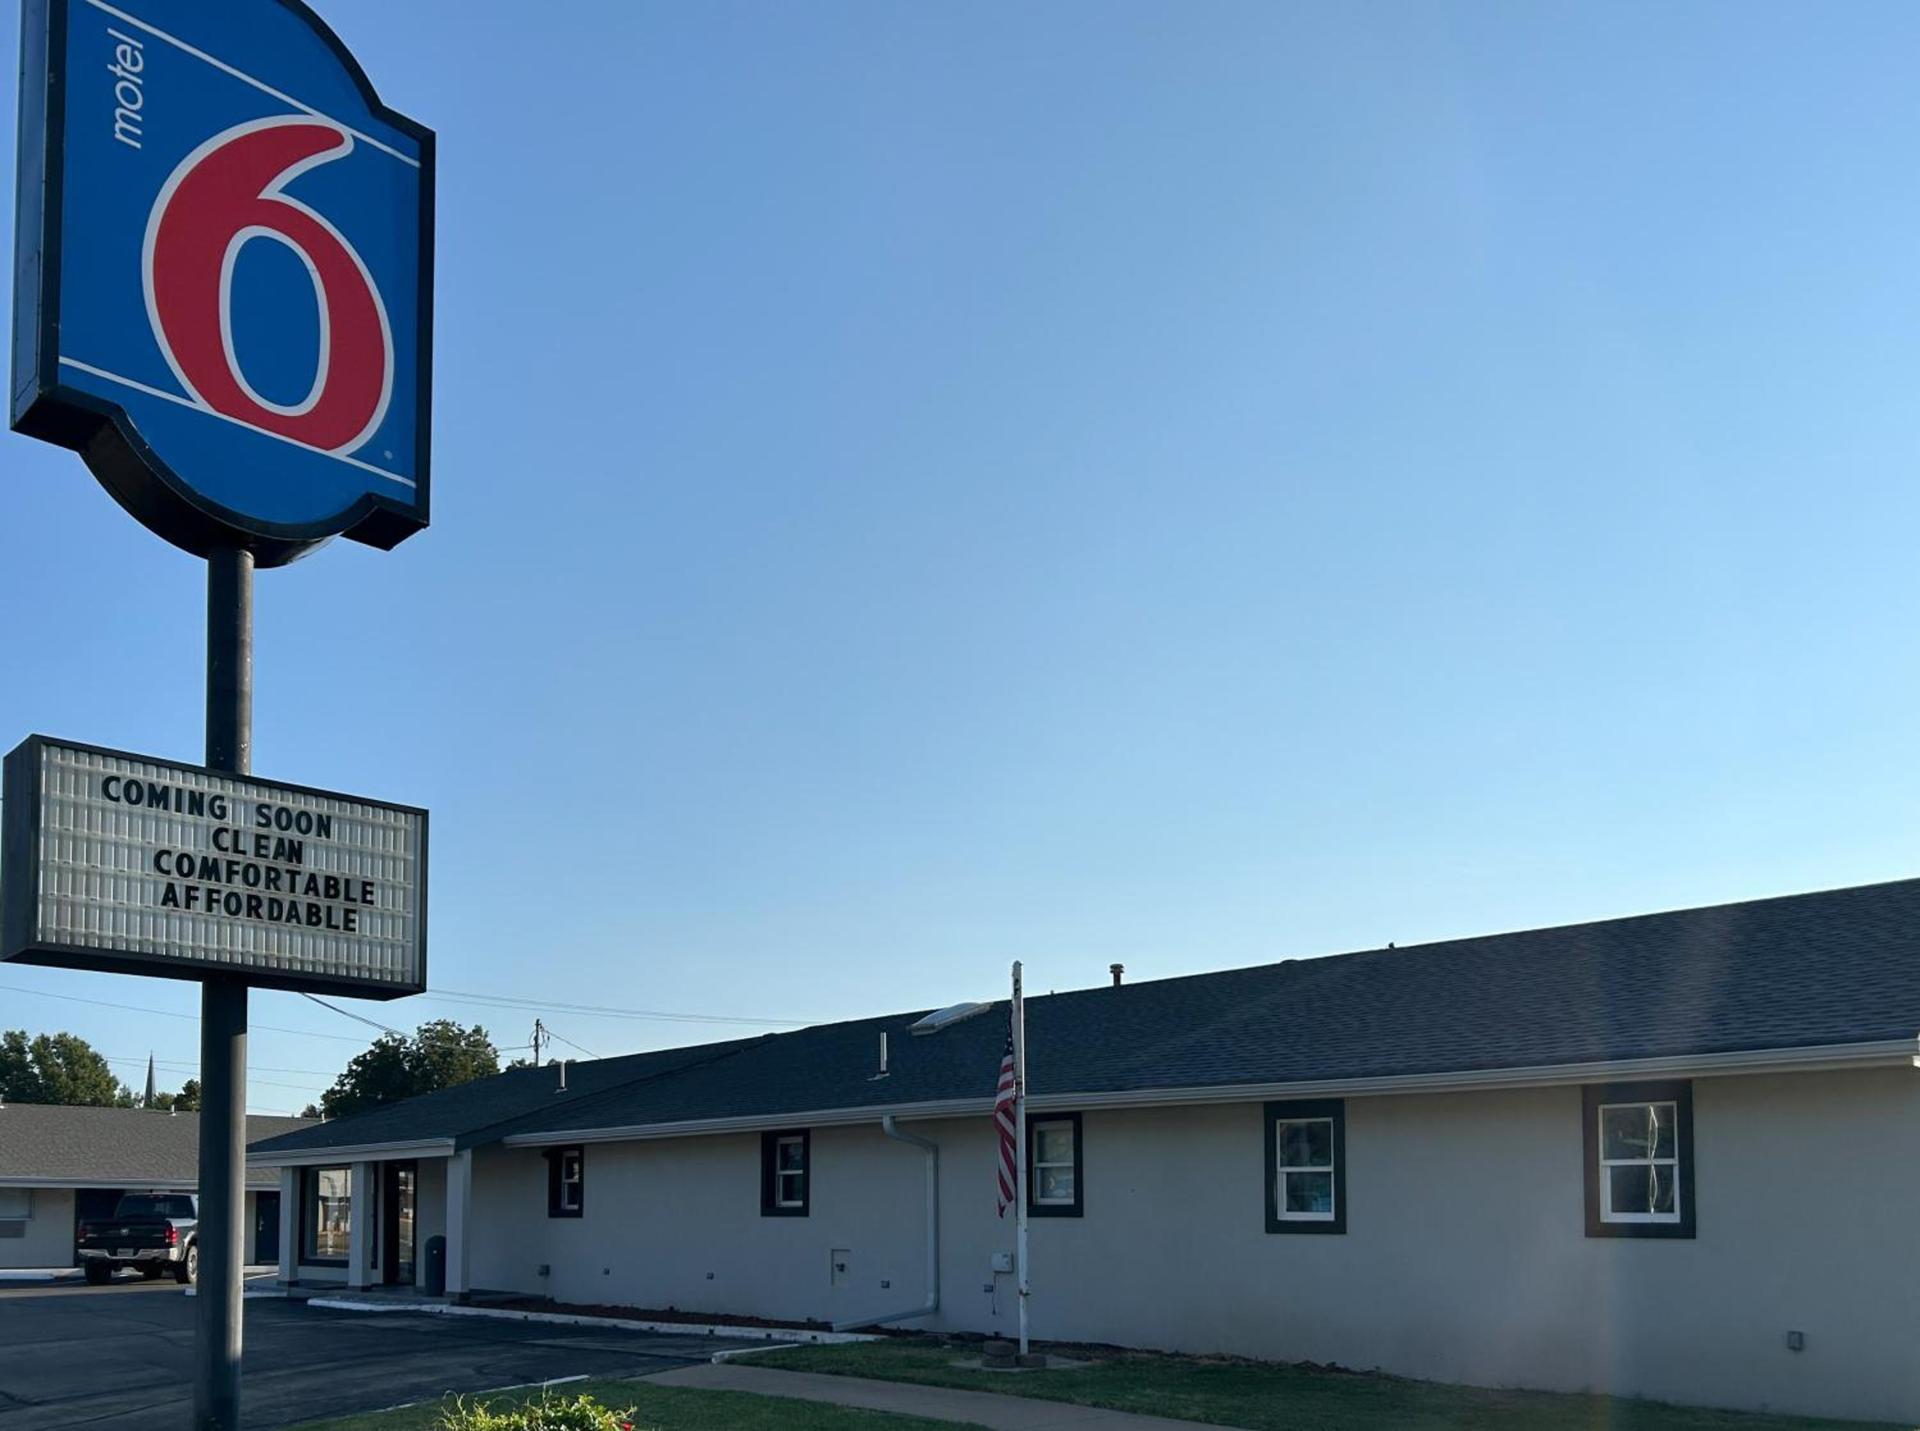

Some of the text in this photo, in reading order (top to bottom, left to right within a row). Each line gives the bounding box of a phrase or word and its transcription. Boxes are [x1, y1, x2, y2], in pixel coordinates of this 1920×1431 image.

[107, 28, 144, 149] motel
[141, 114, 394, 457] 6
[102, 775, 332, 840] COMING SOON
[212, 826, 303, 865] CLEAN
[153, 849, 374, 906] COMFORTABLE
[161, 882, 357, 932] AFFORDABLE
